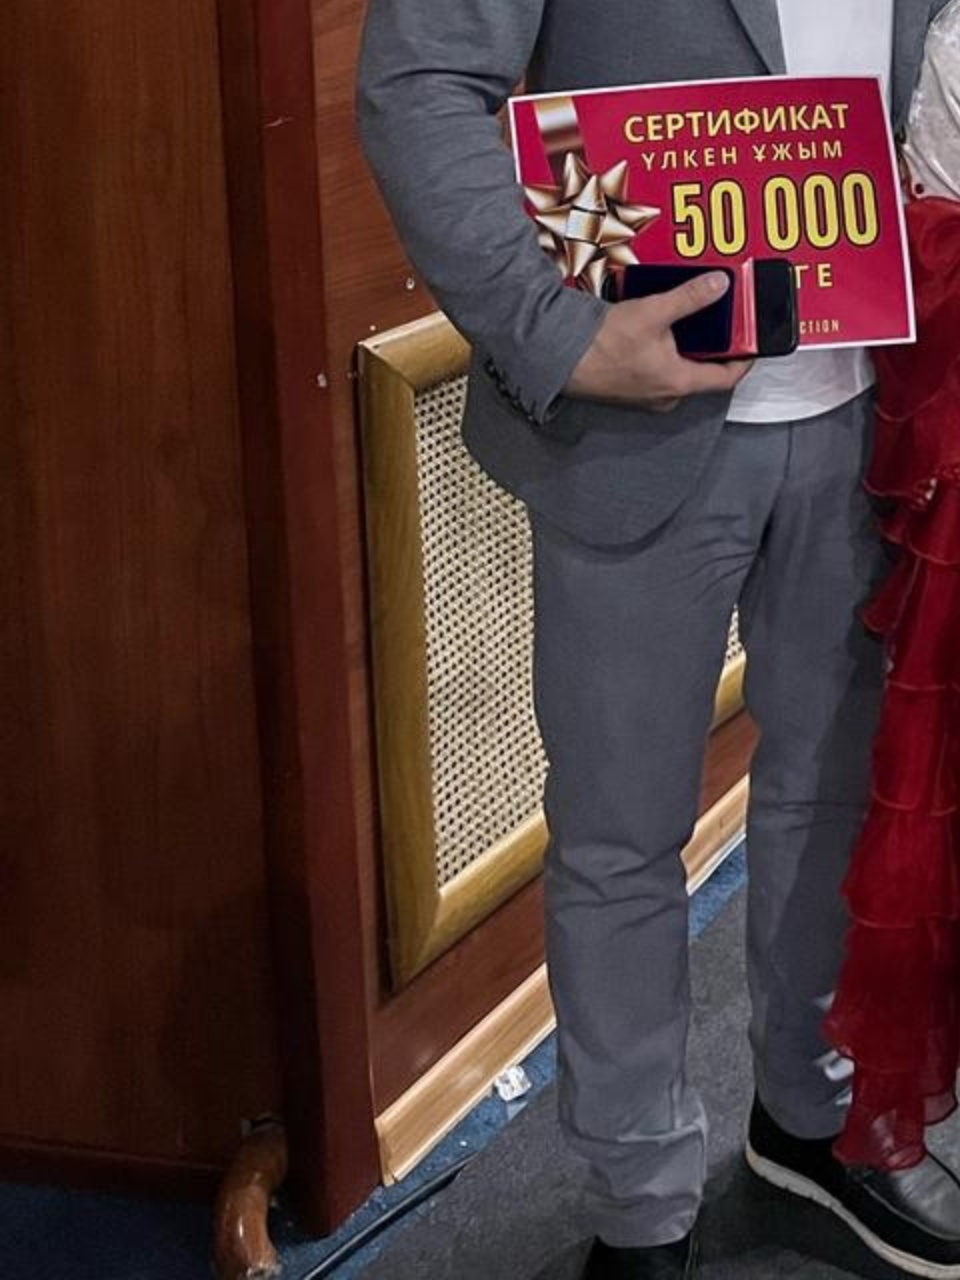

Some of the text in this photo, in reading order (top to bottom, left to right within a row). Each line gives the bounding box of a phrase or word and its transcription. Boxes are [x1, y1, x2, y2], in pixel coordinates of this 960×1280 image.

[624, 103, 849, 143] СЕРТИФИКАТ
[753, 140, 843, 164] ҰЖЫМ
[673, 173, 878, 257] 50 000
[794, 263, 833, 289] ГЕ
[799, 319, 839, 335] CTION
